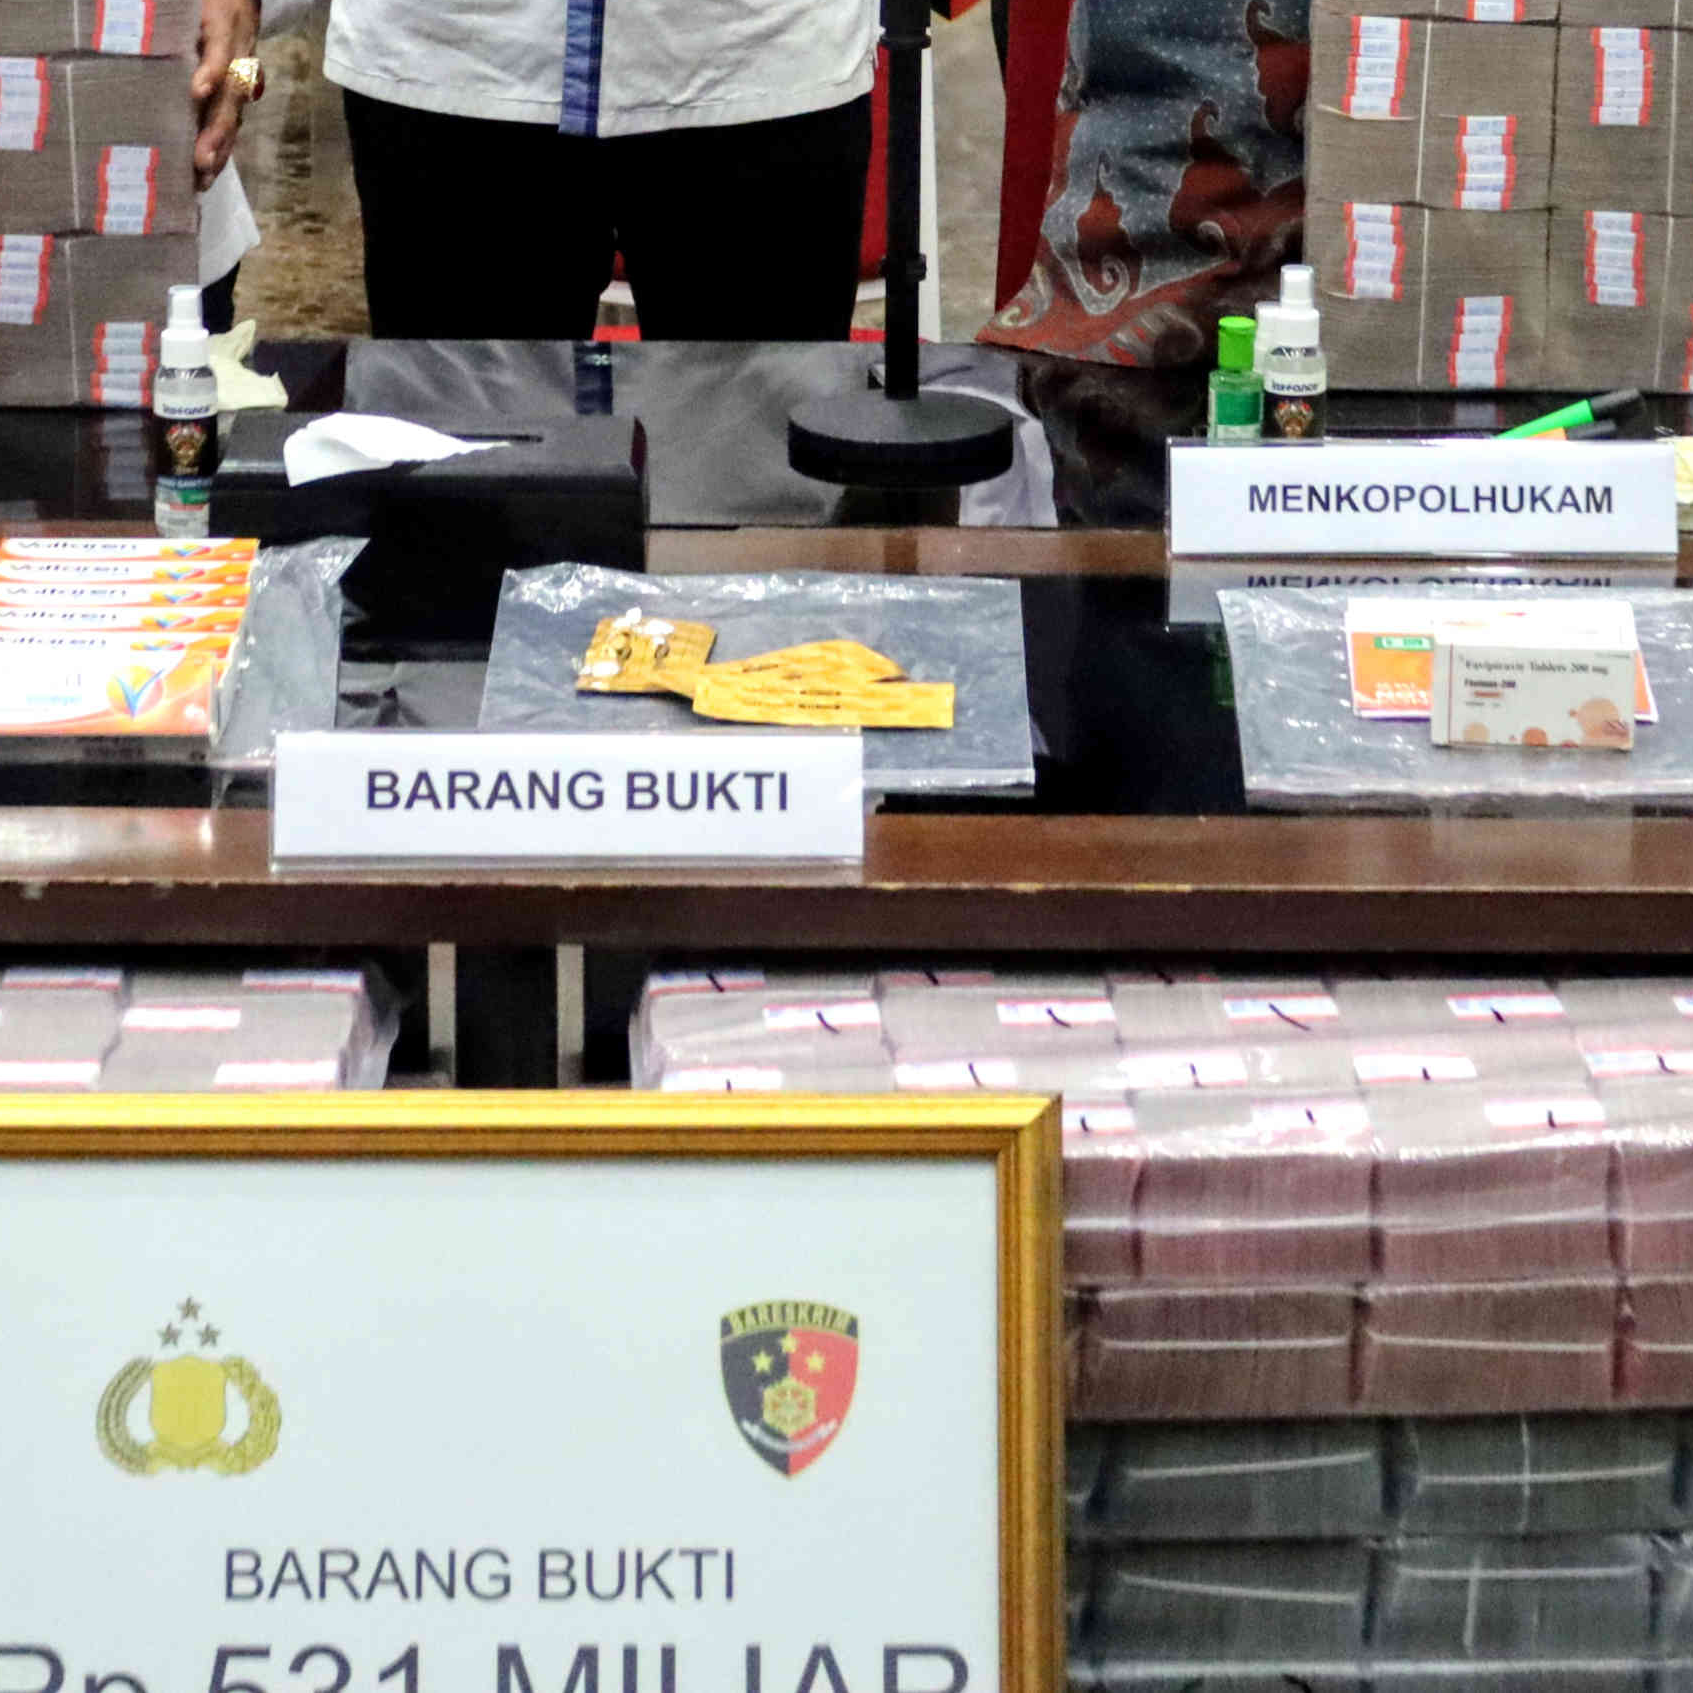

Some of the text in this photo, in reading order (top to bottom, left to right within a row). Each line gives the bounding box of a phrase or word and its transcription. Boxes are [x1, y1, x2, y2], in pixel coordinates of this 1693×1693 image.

[1249, 484, 1613, 514] MENKOPOLHUKAM
[366, 771, 788, 811] BARANG BUKTI
[224, 1548, 734, 1600] BARANG BUKTI
